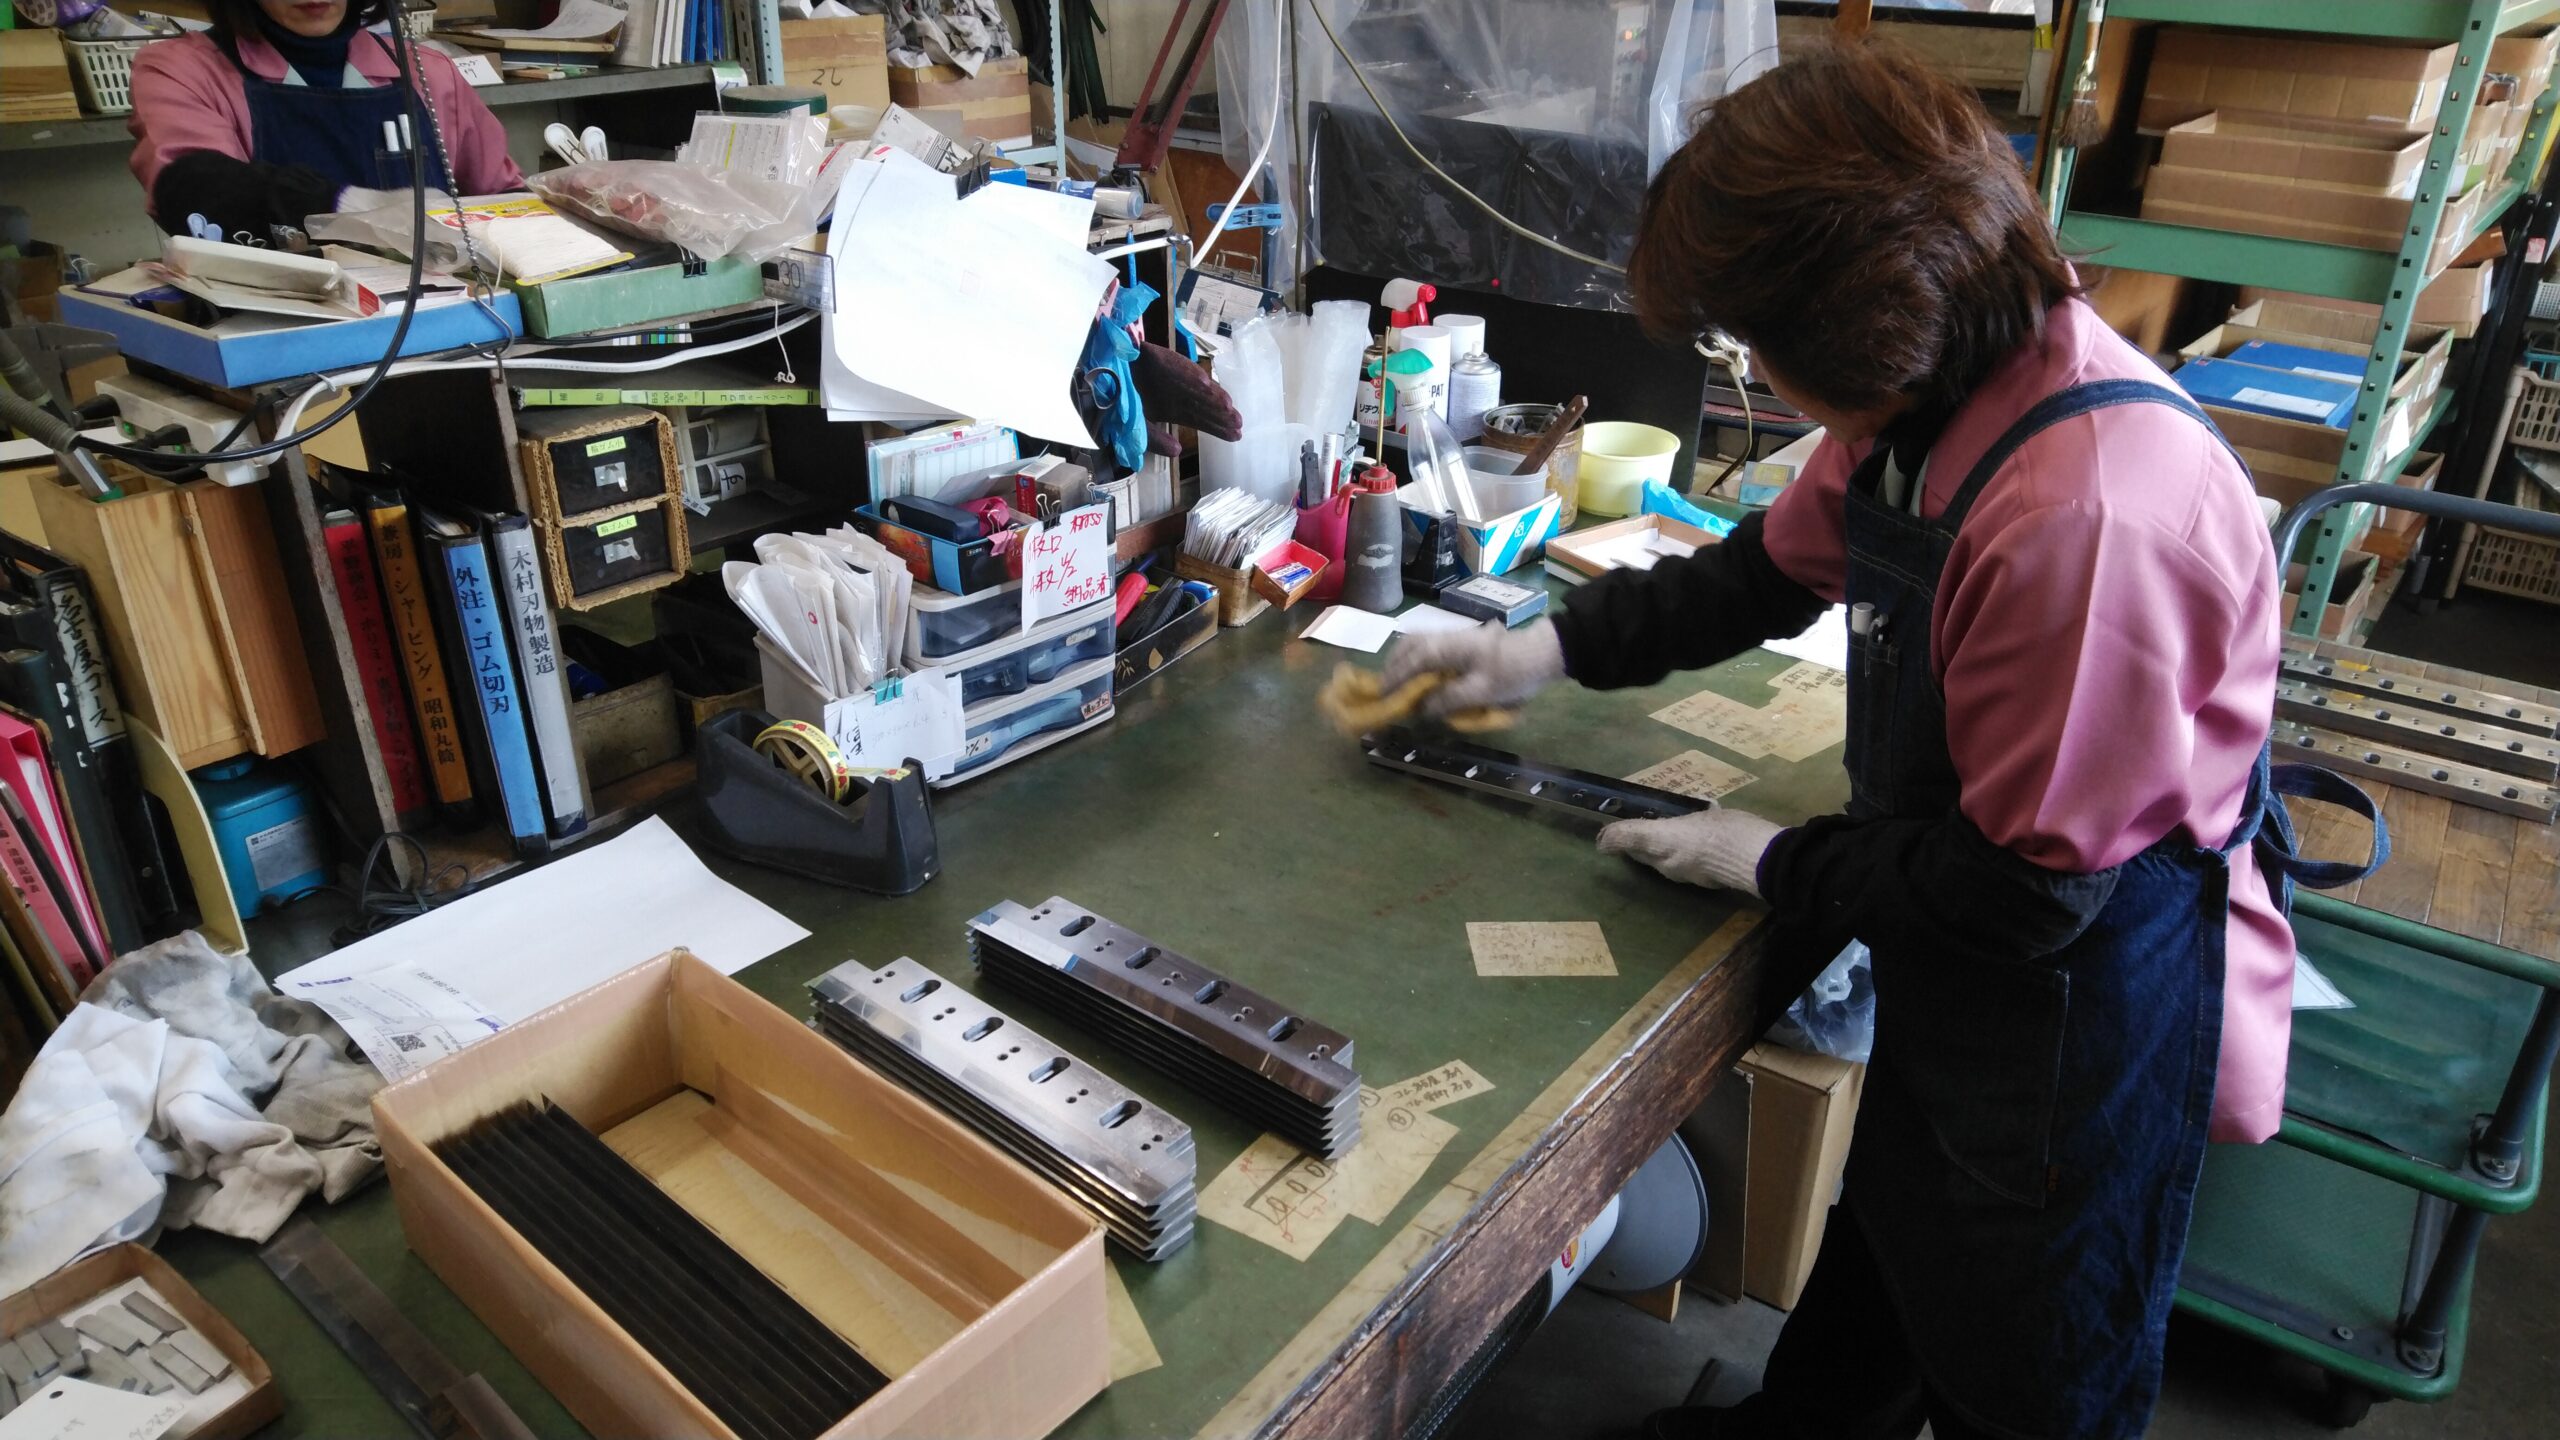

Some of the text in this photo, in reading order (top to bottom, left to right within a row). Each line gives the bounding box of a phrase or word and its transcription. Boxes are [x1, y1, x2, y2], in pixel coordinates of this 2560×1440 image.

[779, 261, 801, 289] 30
[456, 567, 510, 715] 外注・ゴム切刃
[509, 551, 555, 676] 木村刃物製造
